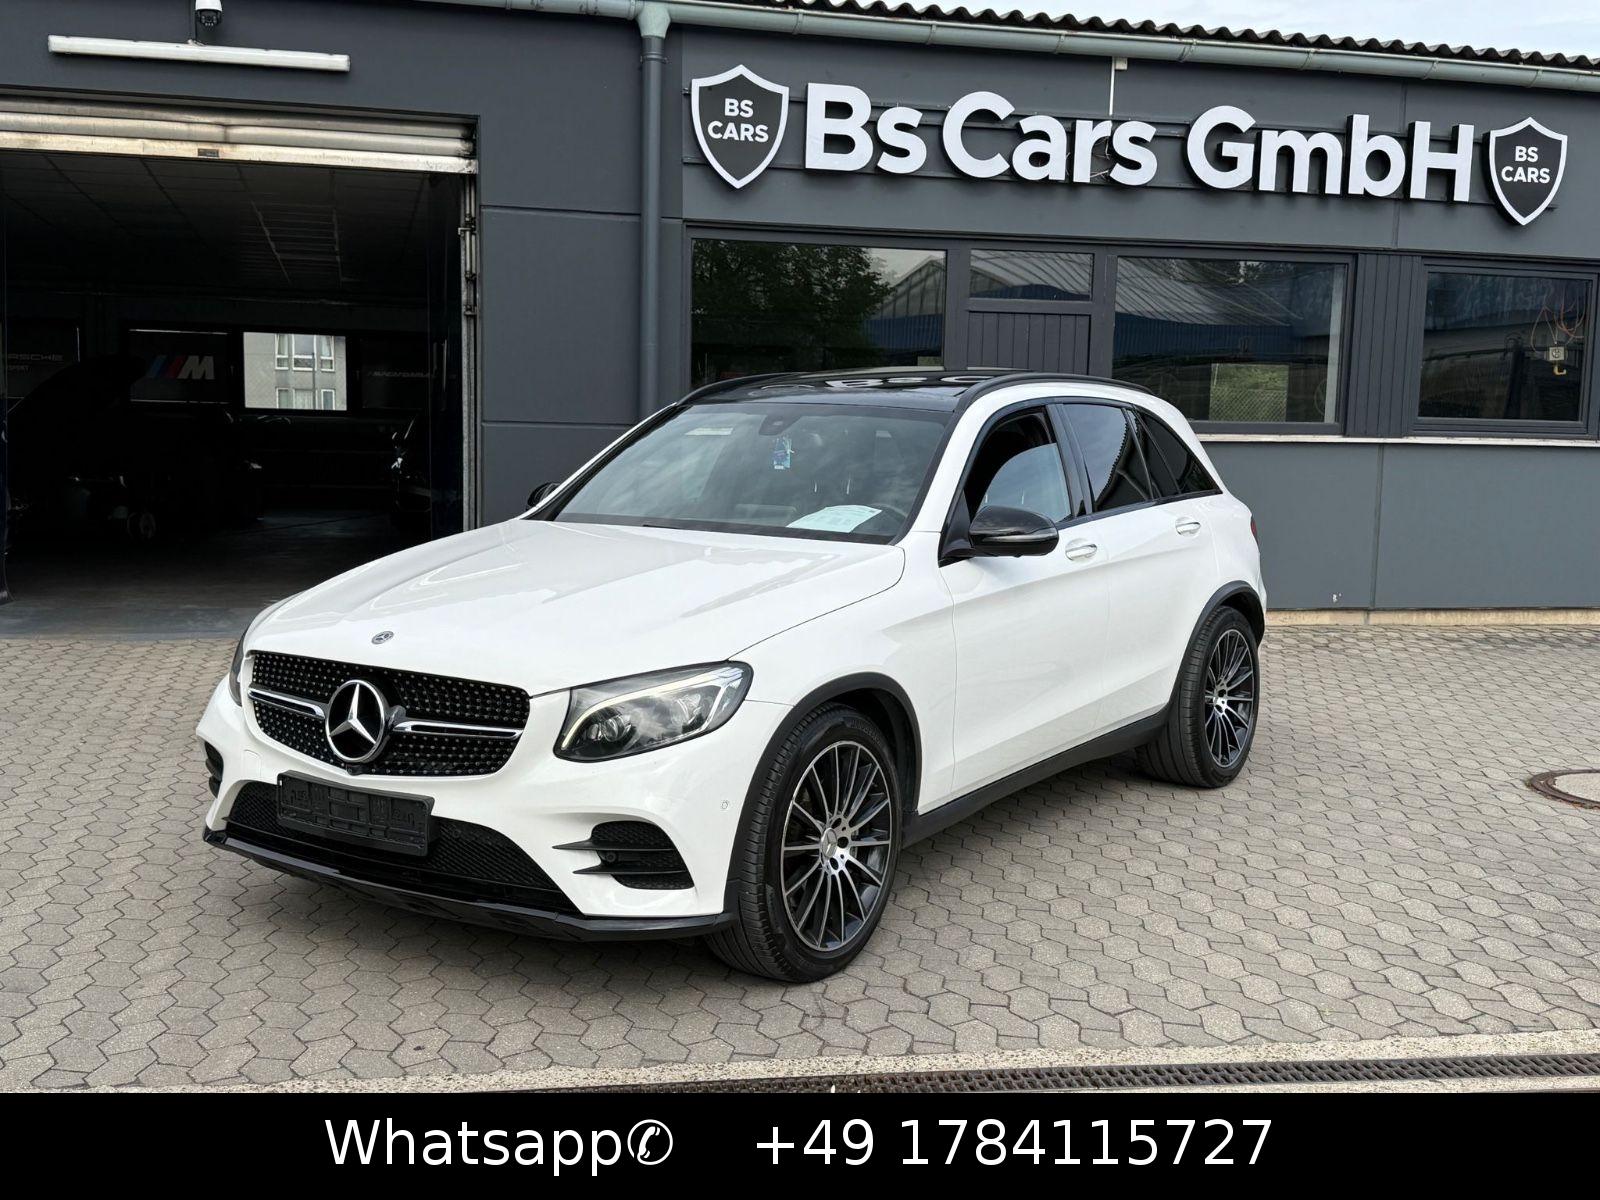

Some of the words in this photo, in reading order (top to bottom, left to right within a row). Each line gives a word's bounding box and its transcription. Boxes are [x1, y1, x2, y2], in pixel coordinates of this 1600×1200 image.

[724, 98, 754, 118] BS
[707, 120, 769, 143] CARS
[1186, 105, 1475, 202] GmbH
[1514, 145, 1539, 163] BS
[1501, 165, 1551, 184] CARS
